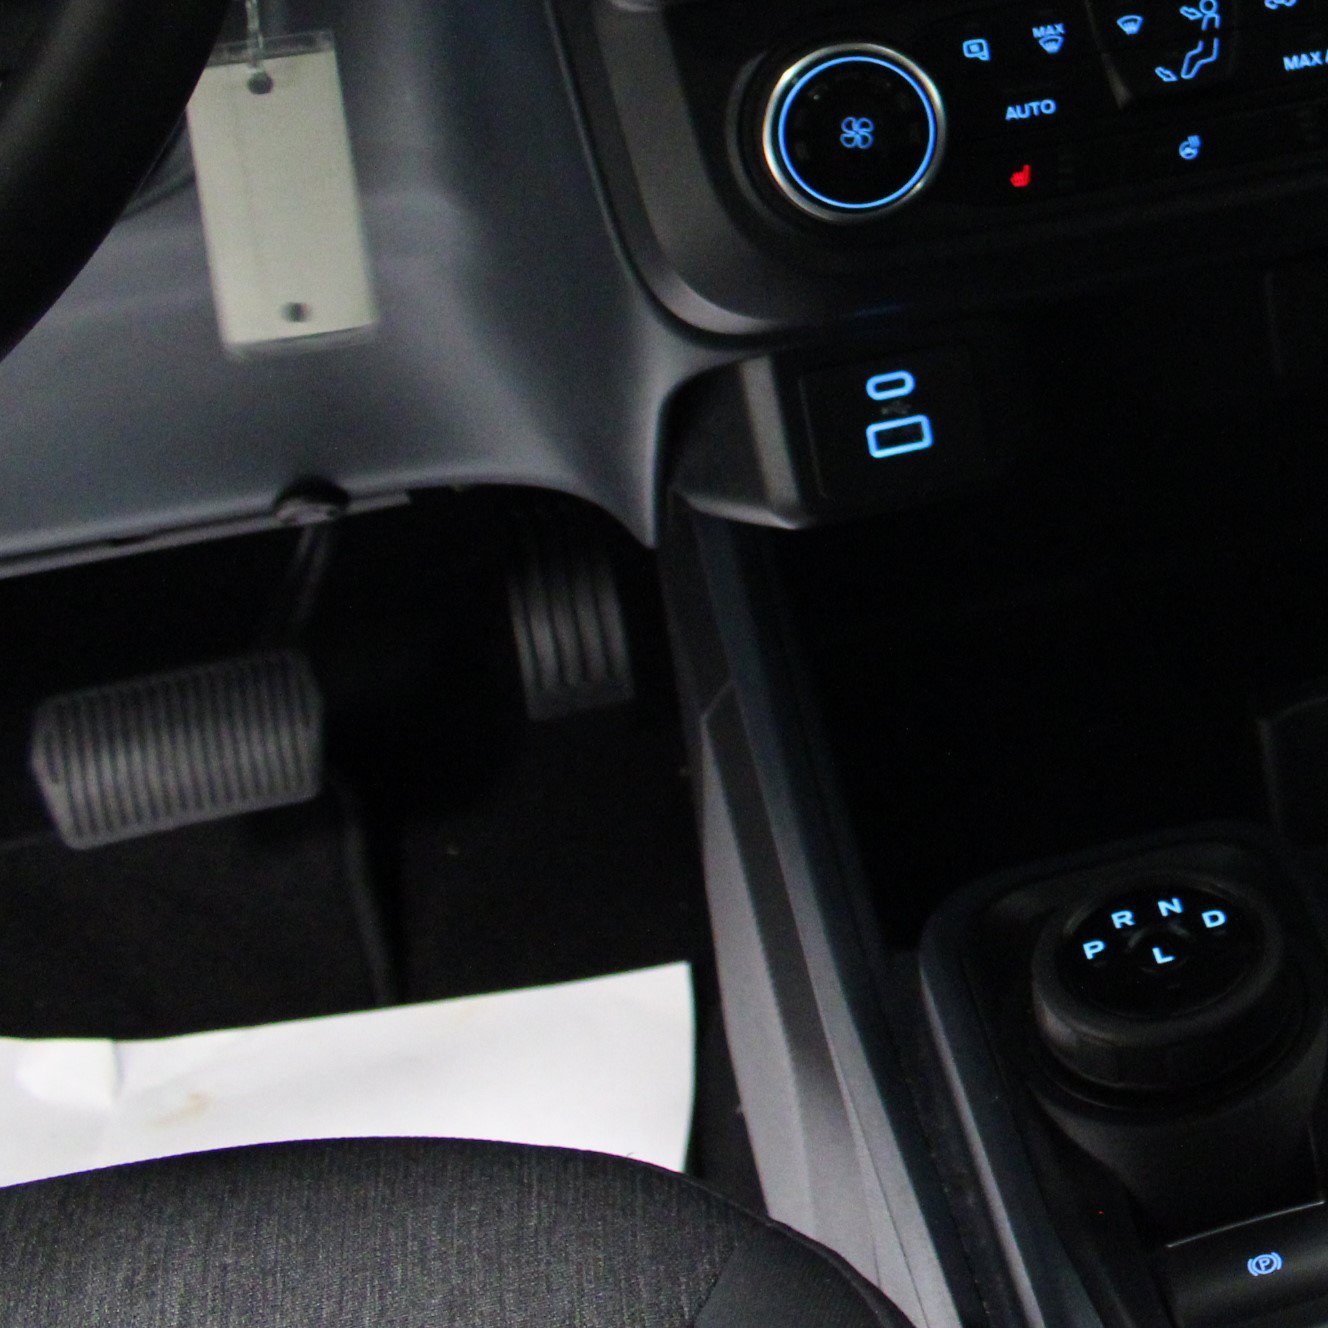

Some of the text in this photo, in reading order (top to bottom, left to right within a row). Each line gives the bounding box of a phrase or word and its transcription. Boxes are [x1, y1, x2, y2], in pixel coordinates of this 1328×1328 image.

[1032, 22, 1066, 39] MAX
[1283, 51, 1324, 72] MAX
[1005, 98, 1057, 121] AUTO
[1083, 897, 1228, 960] P R N D
[1152, 947, 1175, 965] L
